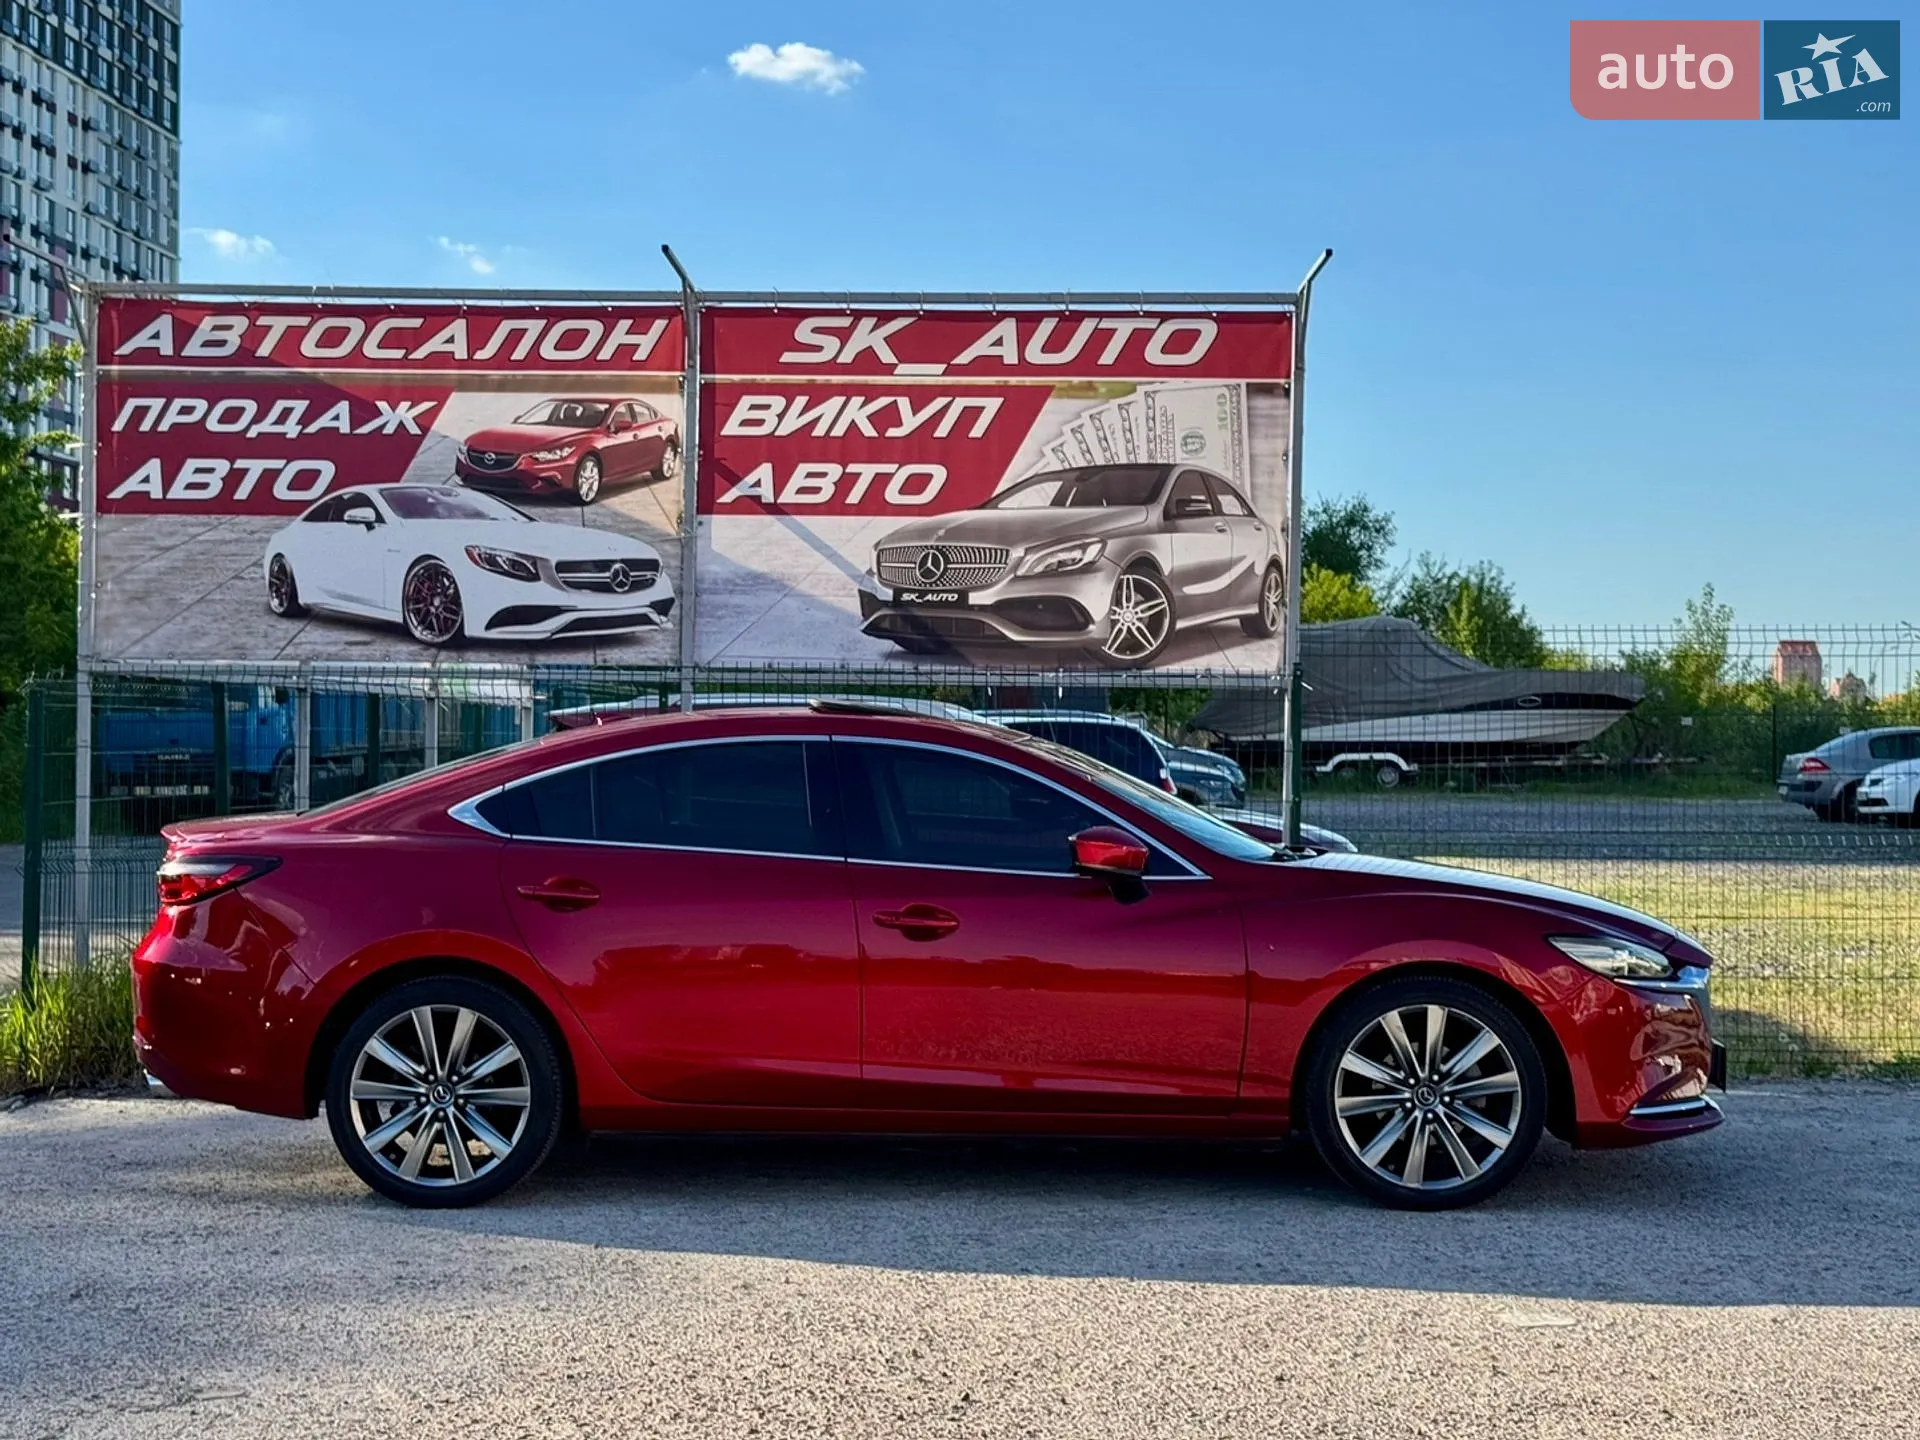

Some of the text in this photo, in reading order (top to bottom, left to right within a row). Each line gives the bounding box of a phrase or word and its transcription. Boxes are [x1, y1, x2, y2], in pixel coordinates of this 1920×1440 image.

[114, 314, 670, 361] АВТОСАЛОН
[779, 316, 1218, 375] SK_AUTO
[111, 397, 438, 439] ПРОДАЖ
[720, 395, 1004, 438] ВИКУП
[107, 458, 335, 501] АВТО
[717, 462, 948, 504] АВТО
[900, 592, 959, 603] SK_AUTO
